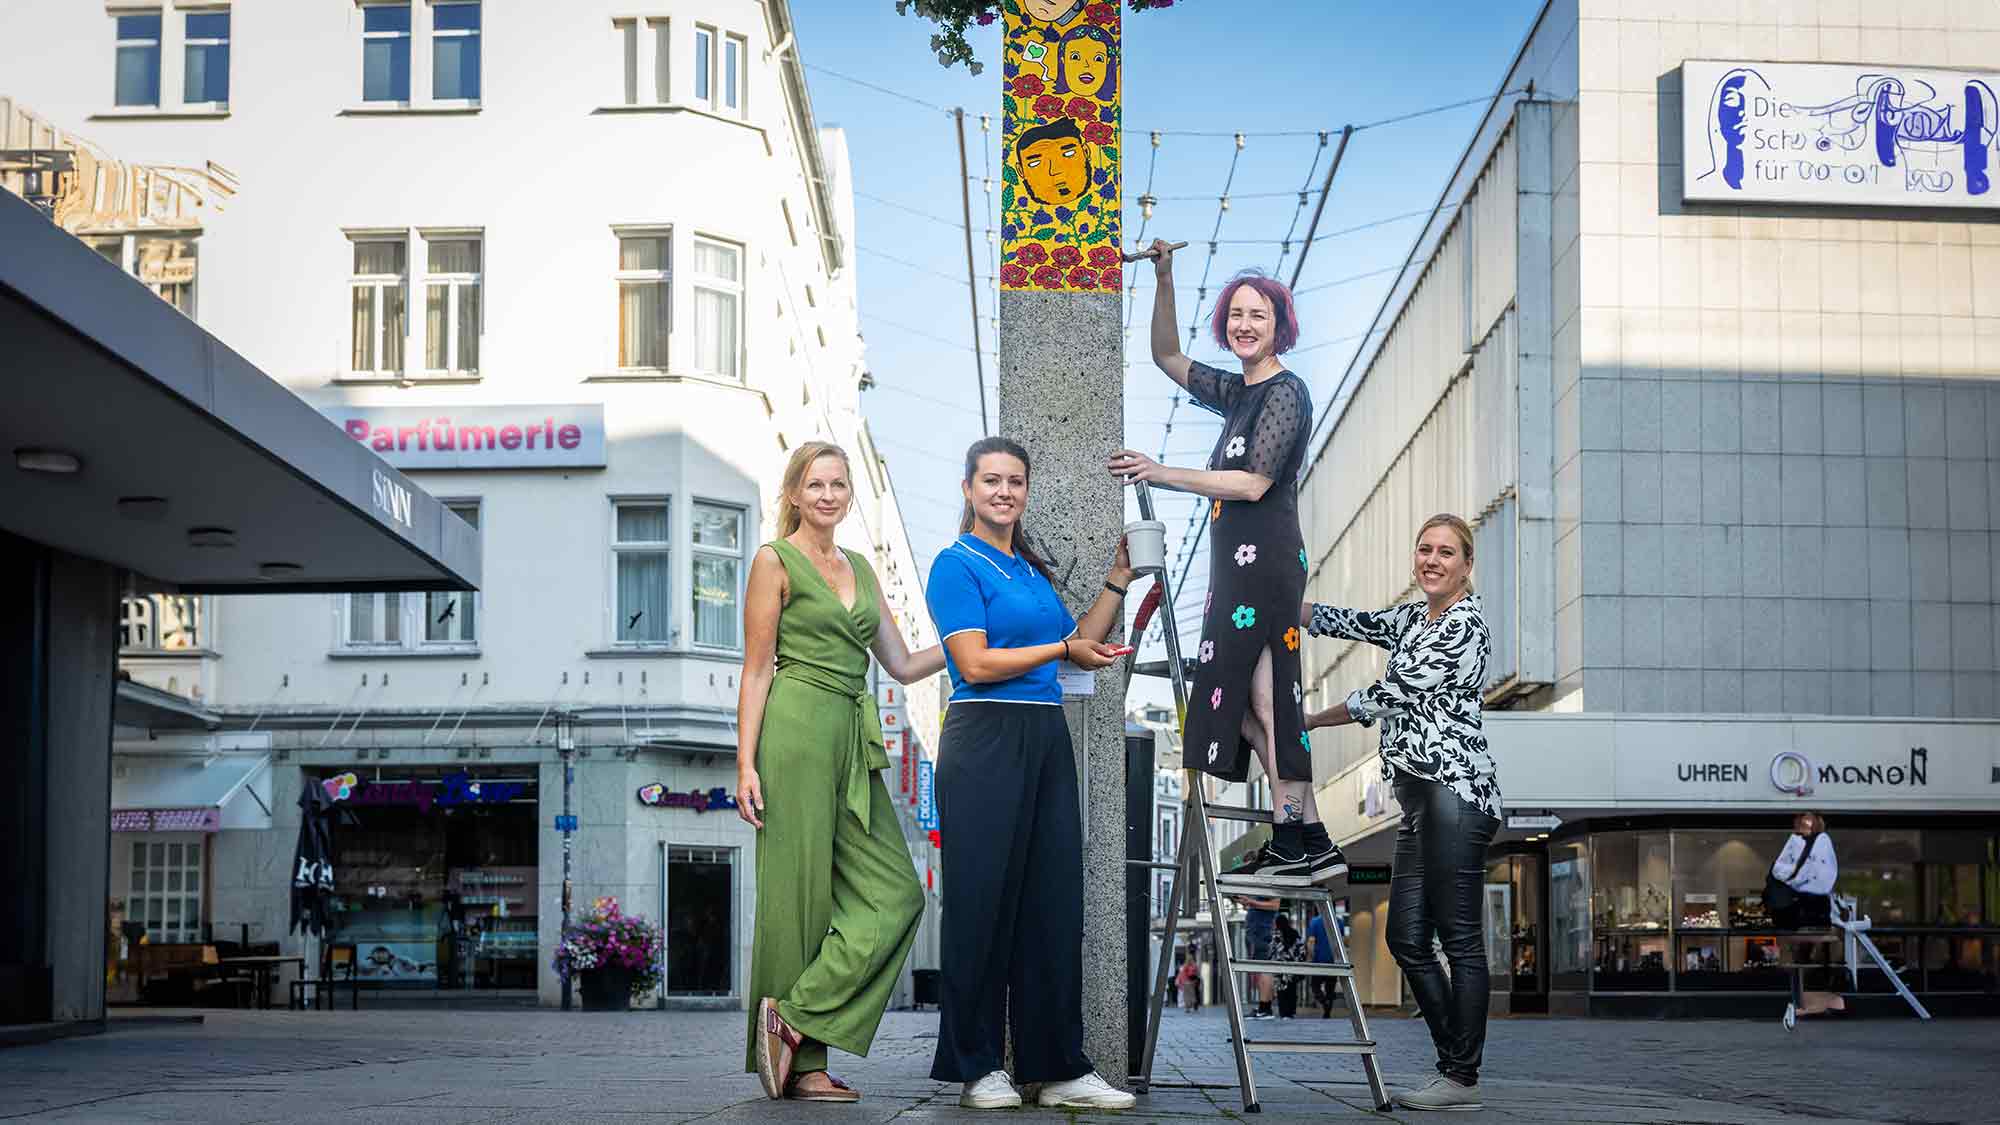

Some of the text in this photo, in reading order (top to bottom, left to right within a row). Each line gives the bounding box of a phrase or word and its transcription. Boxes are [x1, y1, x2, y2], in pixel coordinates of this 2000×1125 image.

[1754, 97, 1792, 118] Die
[1755, 159, 1788, 181] für
[346, 416, 582, 452] Parfümerie
[1678, 764, 1748, 783] UHREN
